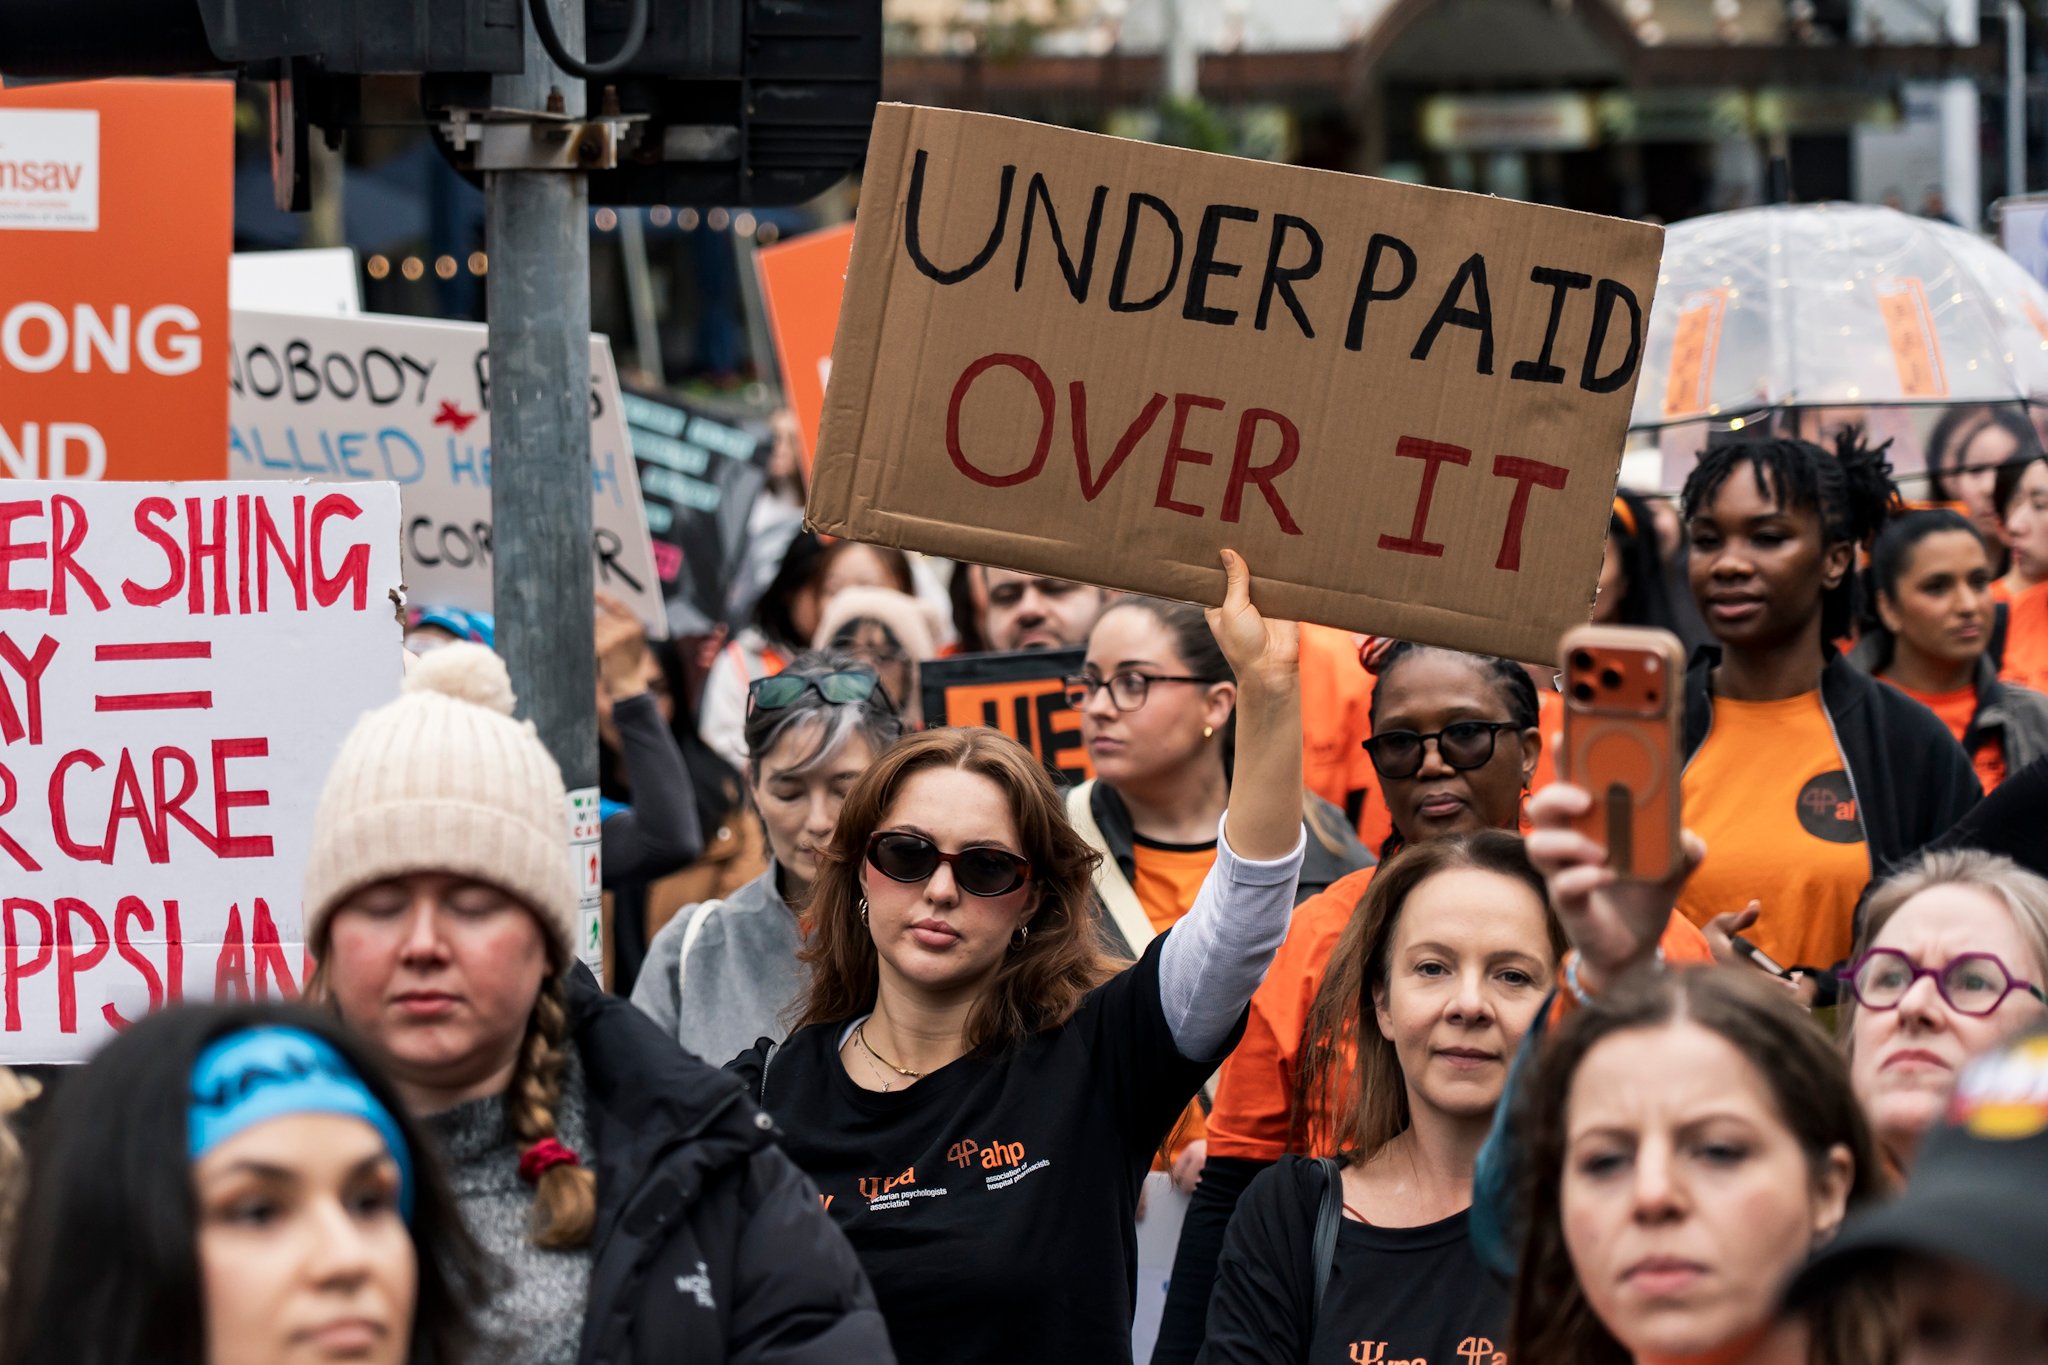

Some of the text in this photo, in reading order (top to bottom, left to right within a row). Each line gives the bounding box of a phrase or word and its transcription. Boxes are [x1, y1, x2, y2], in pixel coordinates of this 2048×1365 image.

[0, 302, 202, 376] ONG
[945, 352, 1570, 573] OVER IT
[121, 493, 370, 616] SHING
[48, 736, 274, 865] CARE
[980, 1140, 1025, 1169] ahp
[986, 1168, 1021, 1183] association
[987, 1159, 1050, 1191] hospital pharmacists
[870, 1199, 910, 1211] association
[901, 1188, 947, 1200] psychologists
